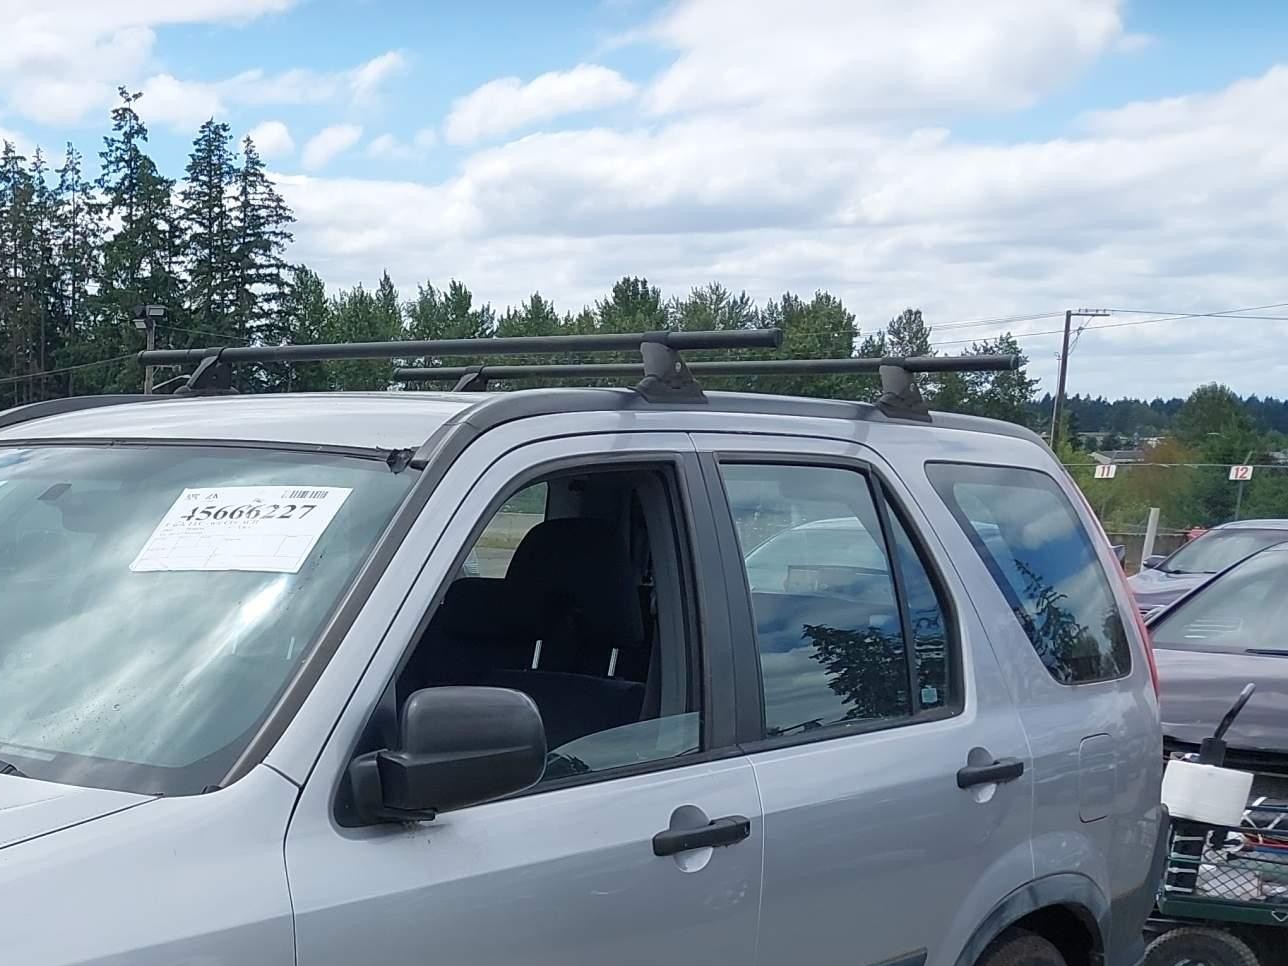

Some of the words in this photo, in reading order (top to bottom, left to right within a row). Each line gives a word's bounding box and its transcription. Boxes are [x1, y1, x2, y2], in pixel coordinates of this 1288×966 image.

[1100, 466, 1111, 477] 11
[1234, 467, 1248, 479] 12
[179, 503, 317, 522] 45666227
